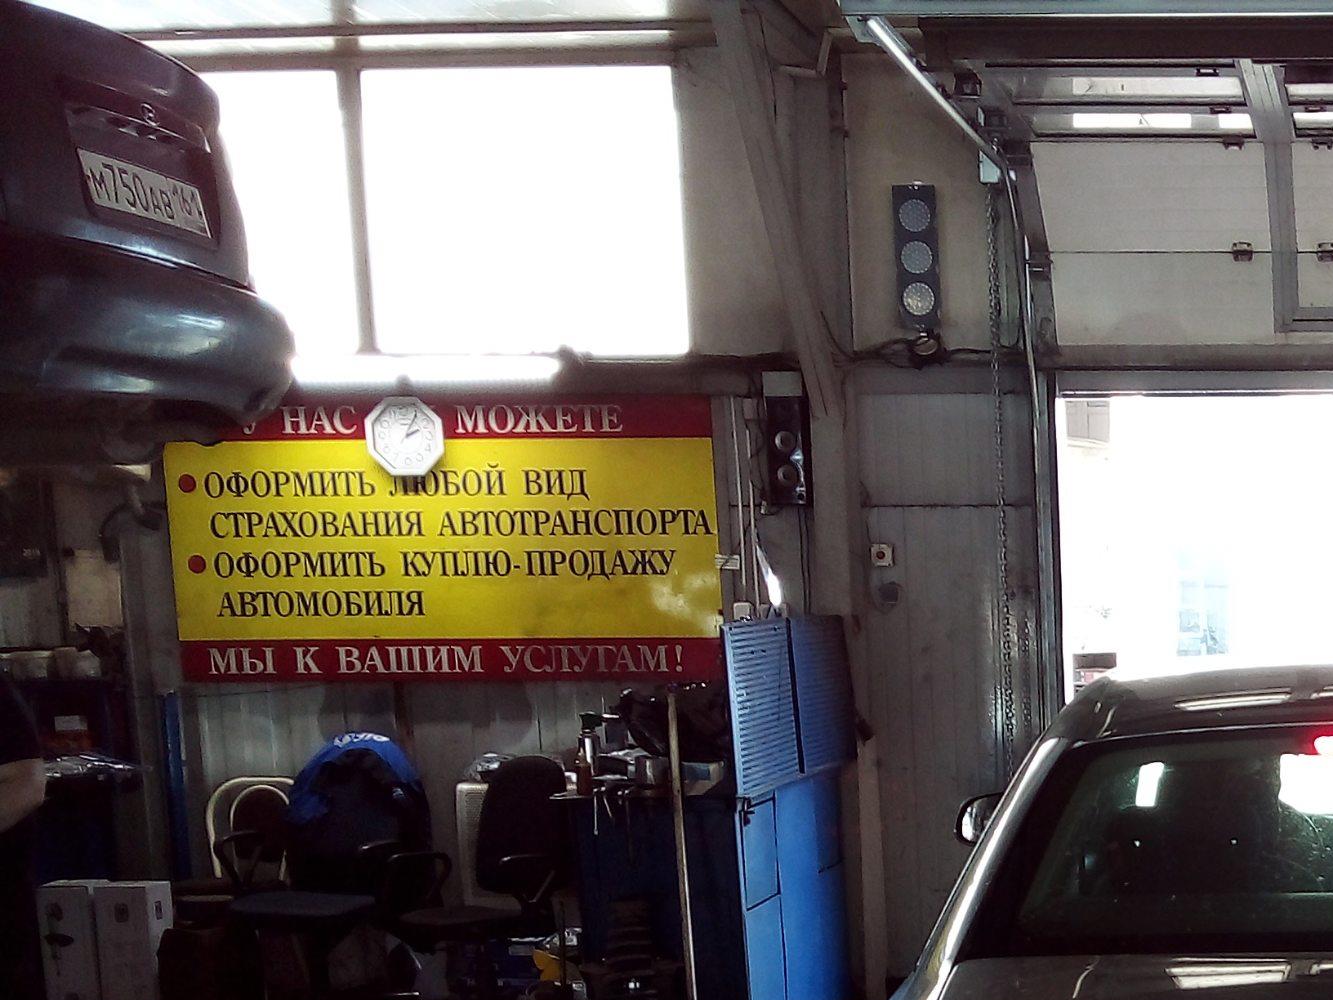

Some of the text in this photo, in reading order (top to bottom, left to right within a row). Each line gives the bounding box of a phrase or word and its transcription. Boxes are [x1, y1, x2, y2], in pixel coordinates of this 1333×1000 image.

[282, 405, 358, 435] НАС
[454, 404, 624, 434] МОЖЕТЕ
[204, 470, 376, 499] ОФОРМИТЬ
[522, 469, 590, 500] ВИД
[209, 509, 714, 539] СТРАХОВАНИЯ АВТОТРАНСПОРТА
[213, 549, 676, 581] ОФОРМИТЬ КУПЛЮ-ПРОДАЖУ
[216, 590, 426, 617] АВТОМОБИЛЯ
[207, 645, 684, 675] МЫ К ВАШИМ УСЛУГАМ!
